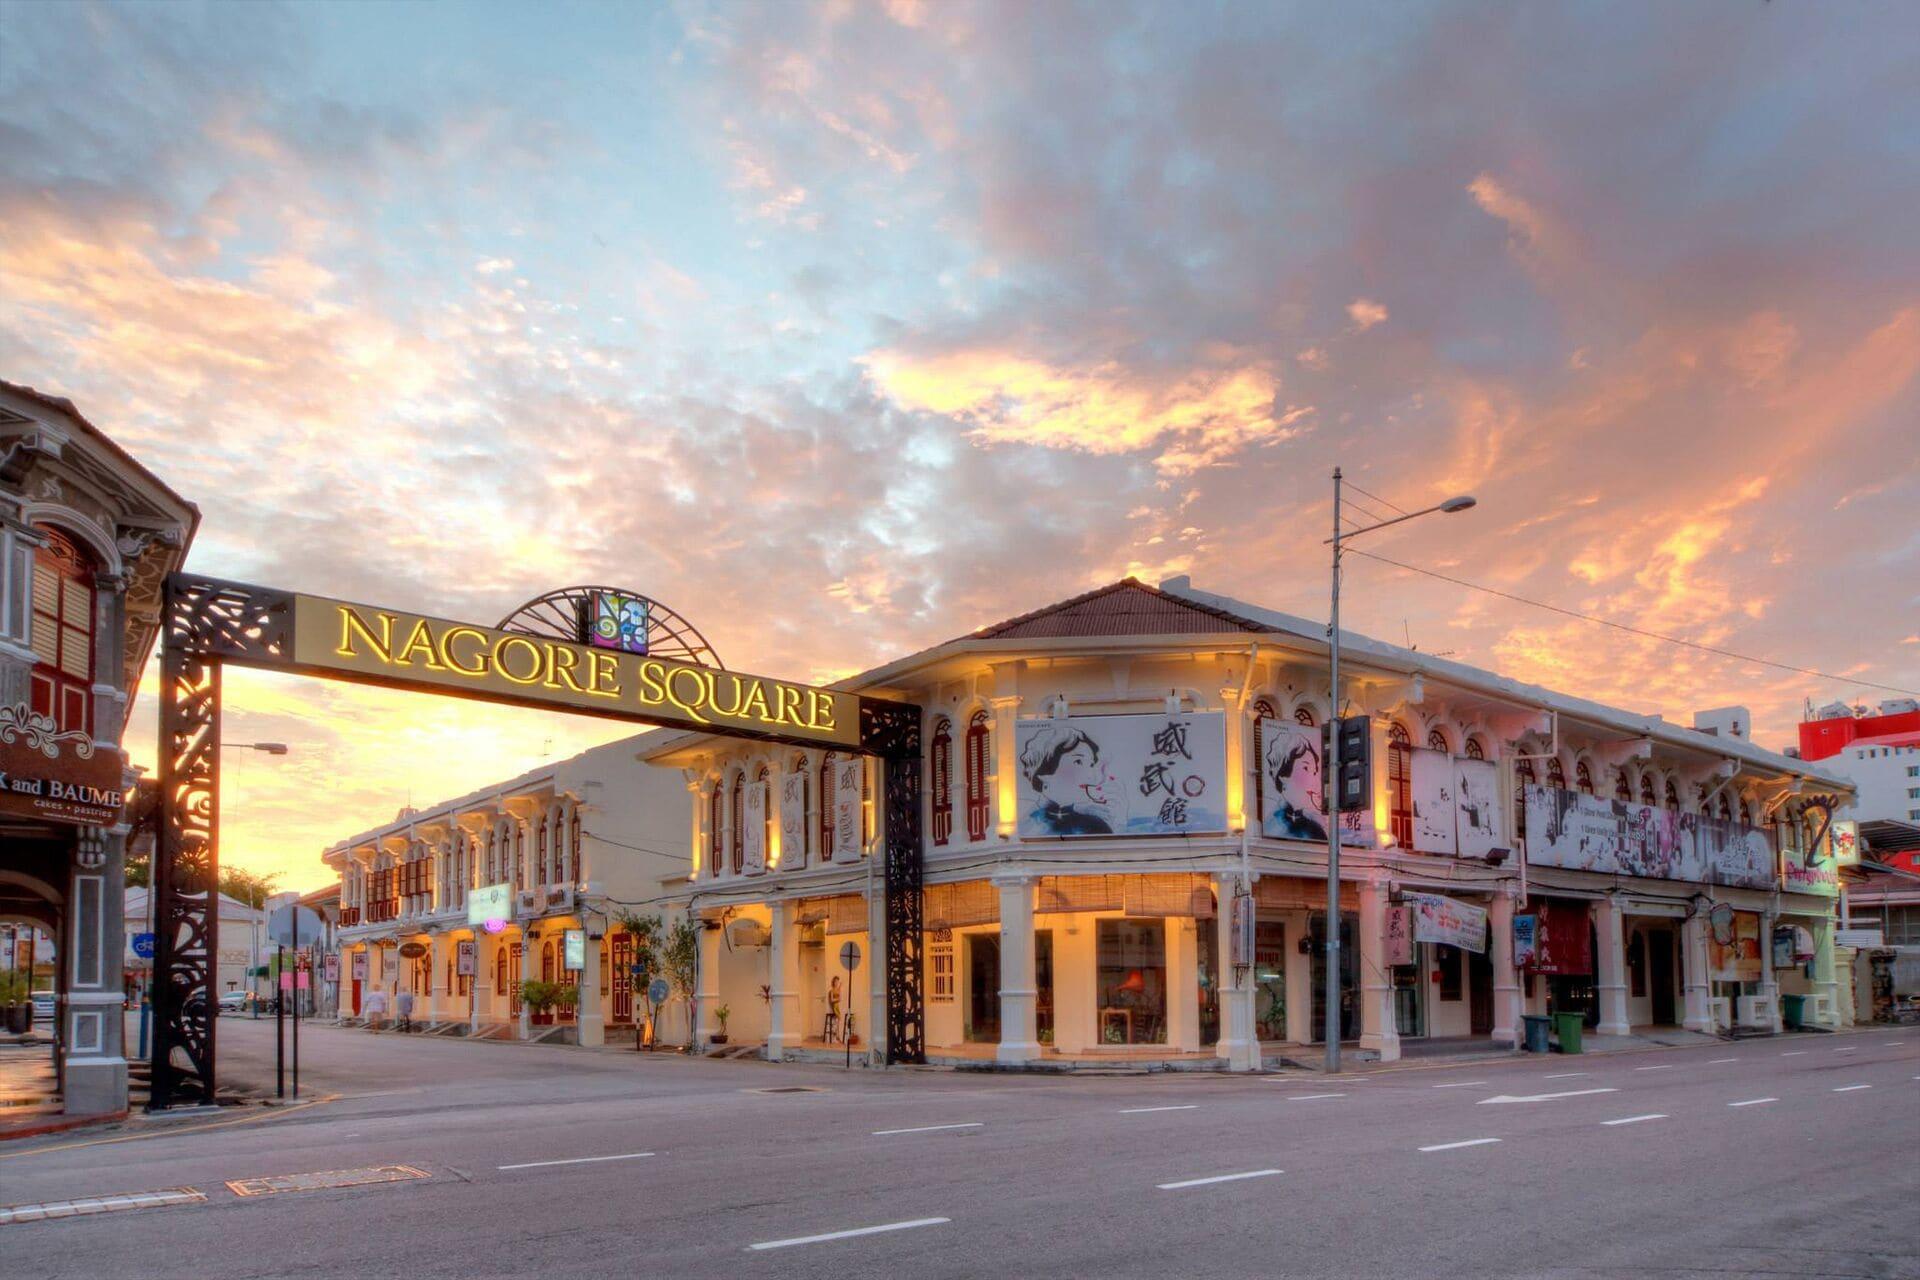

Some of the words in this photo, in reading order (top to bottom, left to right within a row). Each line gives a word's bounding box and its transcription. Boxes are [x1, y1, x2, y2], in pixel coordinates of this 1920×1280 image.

[336, 606, 623, 697] NAGORE
[639, 660, 838, 732] SQUARE
[11, 779, 42, 795] and
[48, 780, 122, 807] BAUME
[33, 799, 63, 810] cakes
[73, 806, 113, 818] pastries
